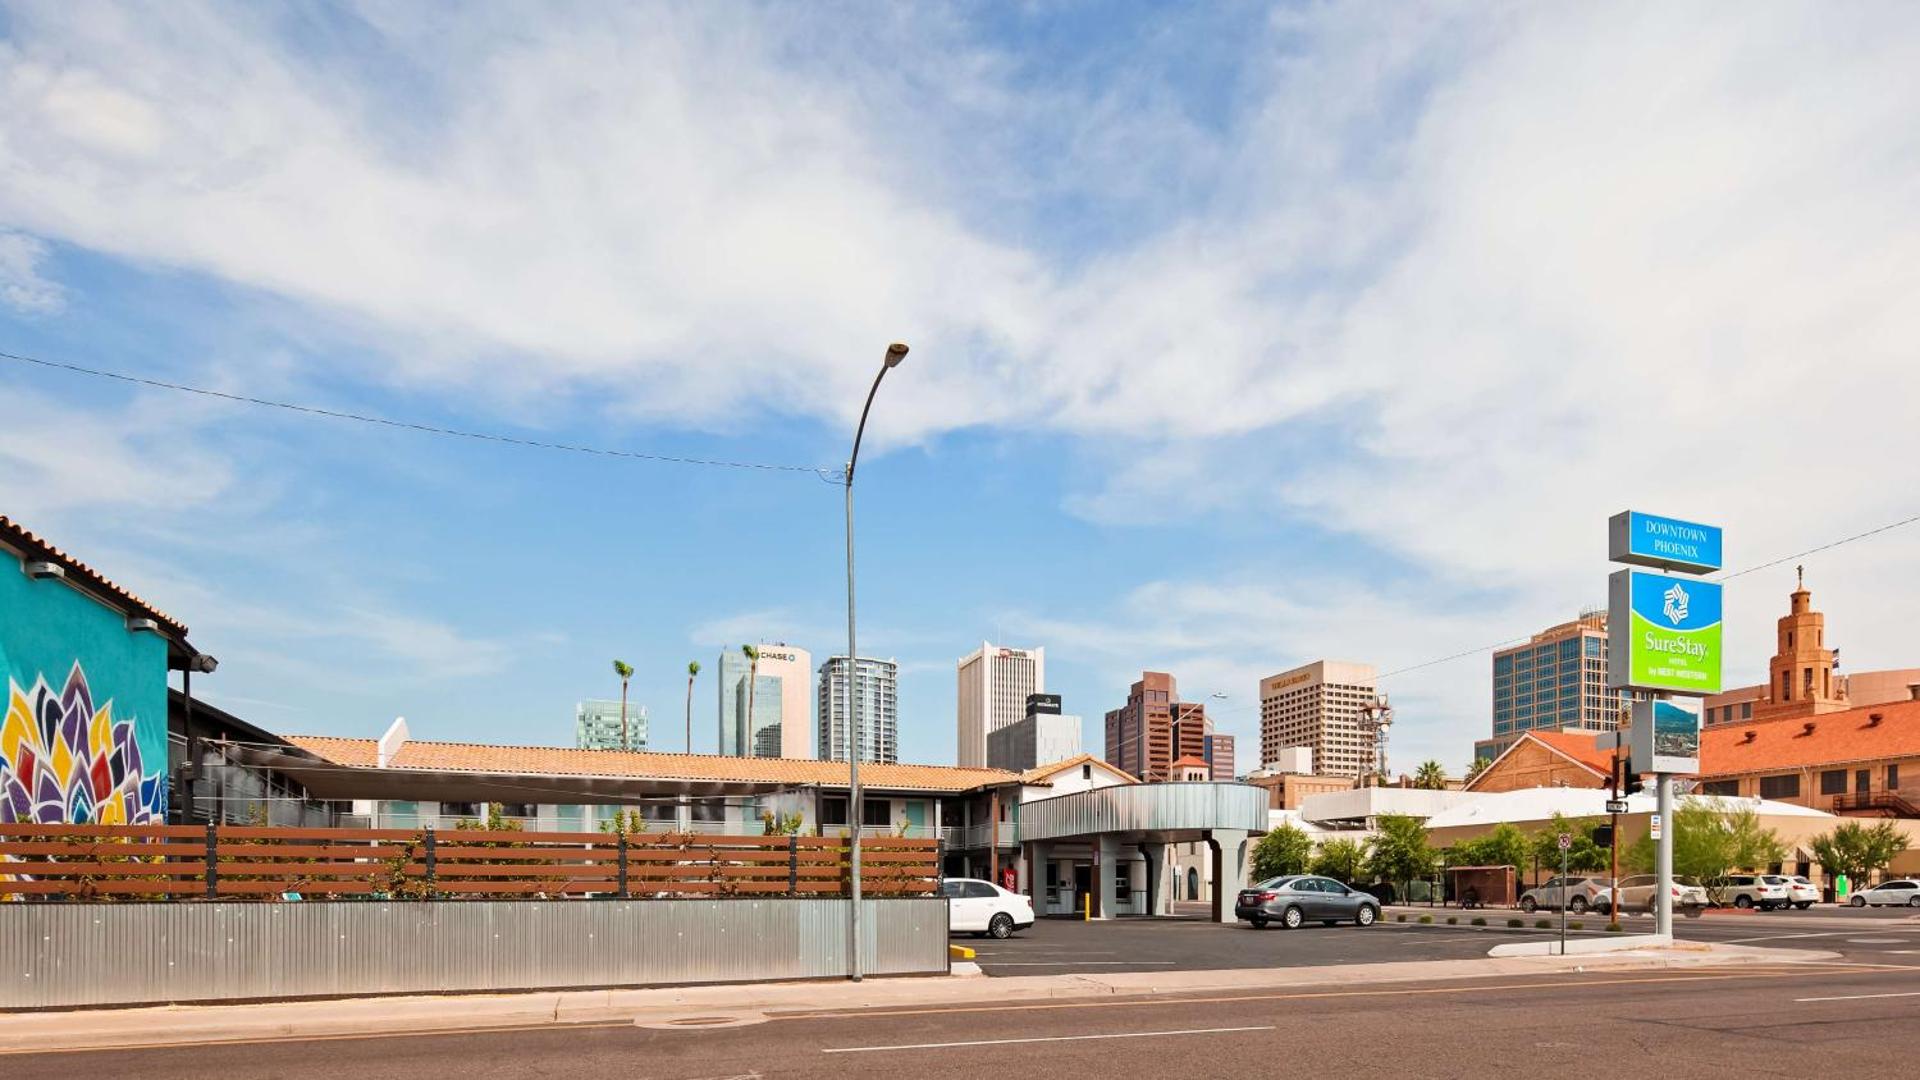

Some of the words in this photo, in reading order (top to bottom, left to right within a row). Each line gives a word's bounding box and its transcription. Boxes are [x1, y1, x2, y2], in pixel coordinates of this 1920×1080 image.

[1647, 520, 1707, 542] DOWNTOWN
[1655, 540, 1698, 557] PHOENIX
[761, 652, 788, 661] CHASE
[1646, 632, 1707, 662] SureStay
